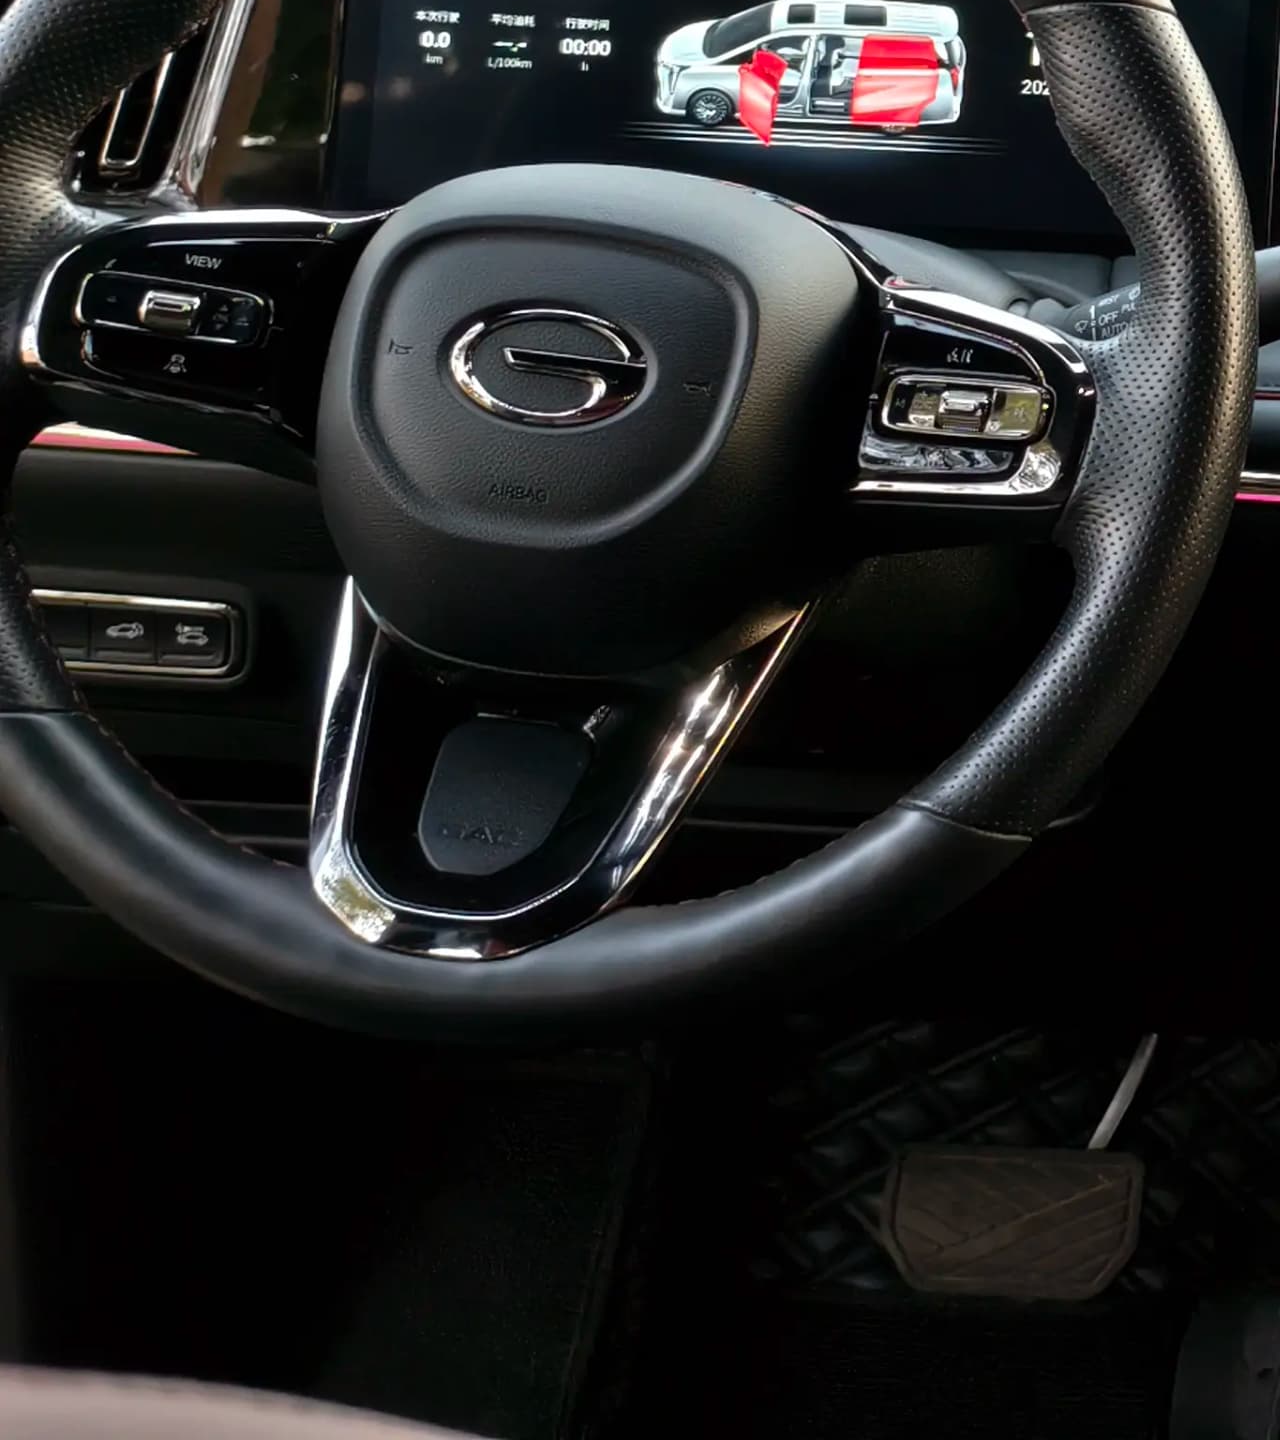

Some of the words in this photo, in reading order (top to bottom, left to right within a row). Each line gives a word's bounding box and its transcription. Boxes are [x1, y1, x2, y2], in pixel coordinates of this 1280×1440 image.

[419, 30, 451, 49] 0.0
[559, 37, 612, 57] 00:00
[184, 252, 222, 270] VIEW
[1098, 310, 1120, 327] OFF
[487, 483, 548, 505] AIRBAG
